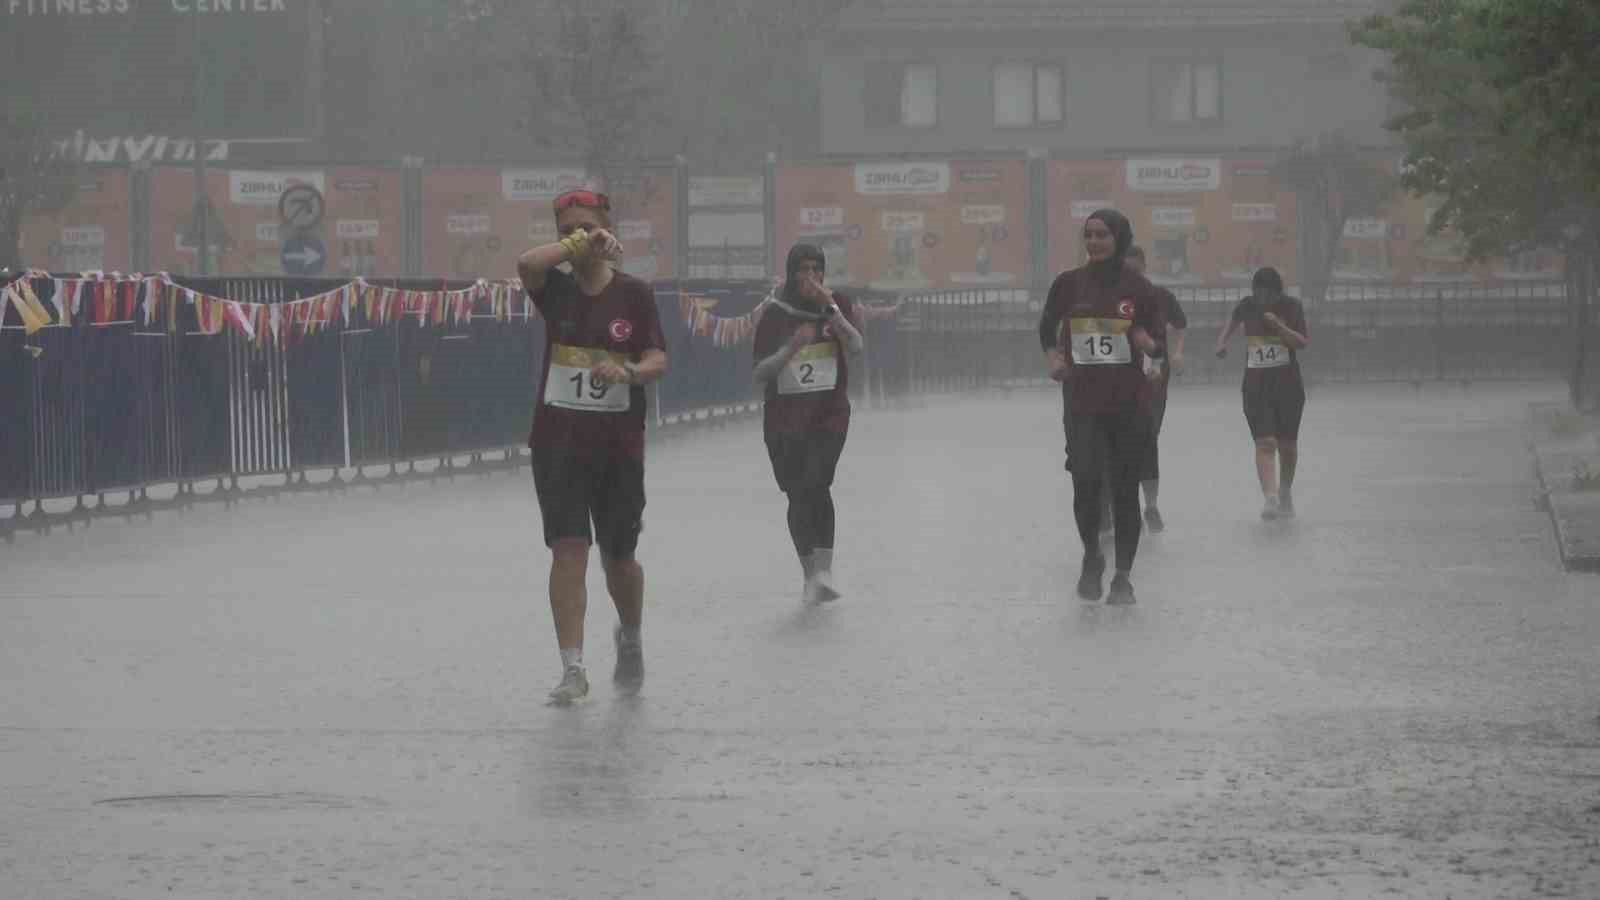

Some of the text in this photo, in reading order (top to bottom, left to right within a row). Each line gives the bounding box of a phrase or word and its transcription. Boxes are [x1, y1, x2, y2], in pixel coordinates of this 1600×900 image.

[9, 0, 287, 14] FITNESS CENTER
[1085, 335, 1113, 356] 15
[1255, 346, 1277, 363] 14
[799, 363, 815, 384] 2
[569, 371, 609, 399] 19
